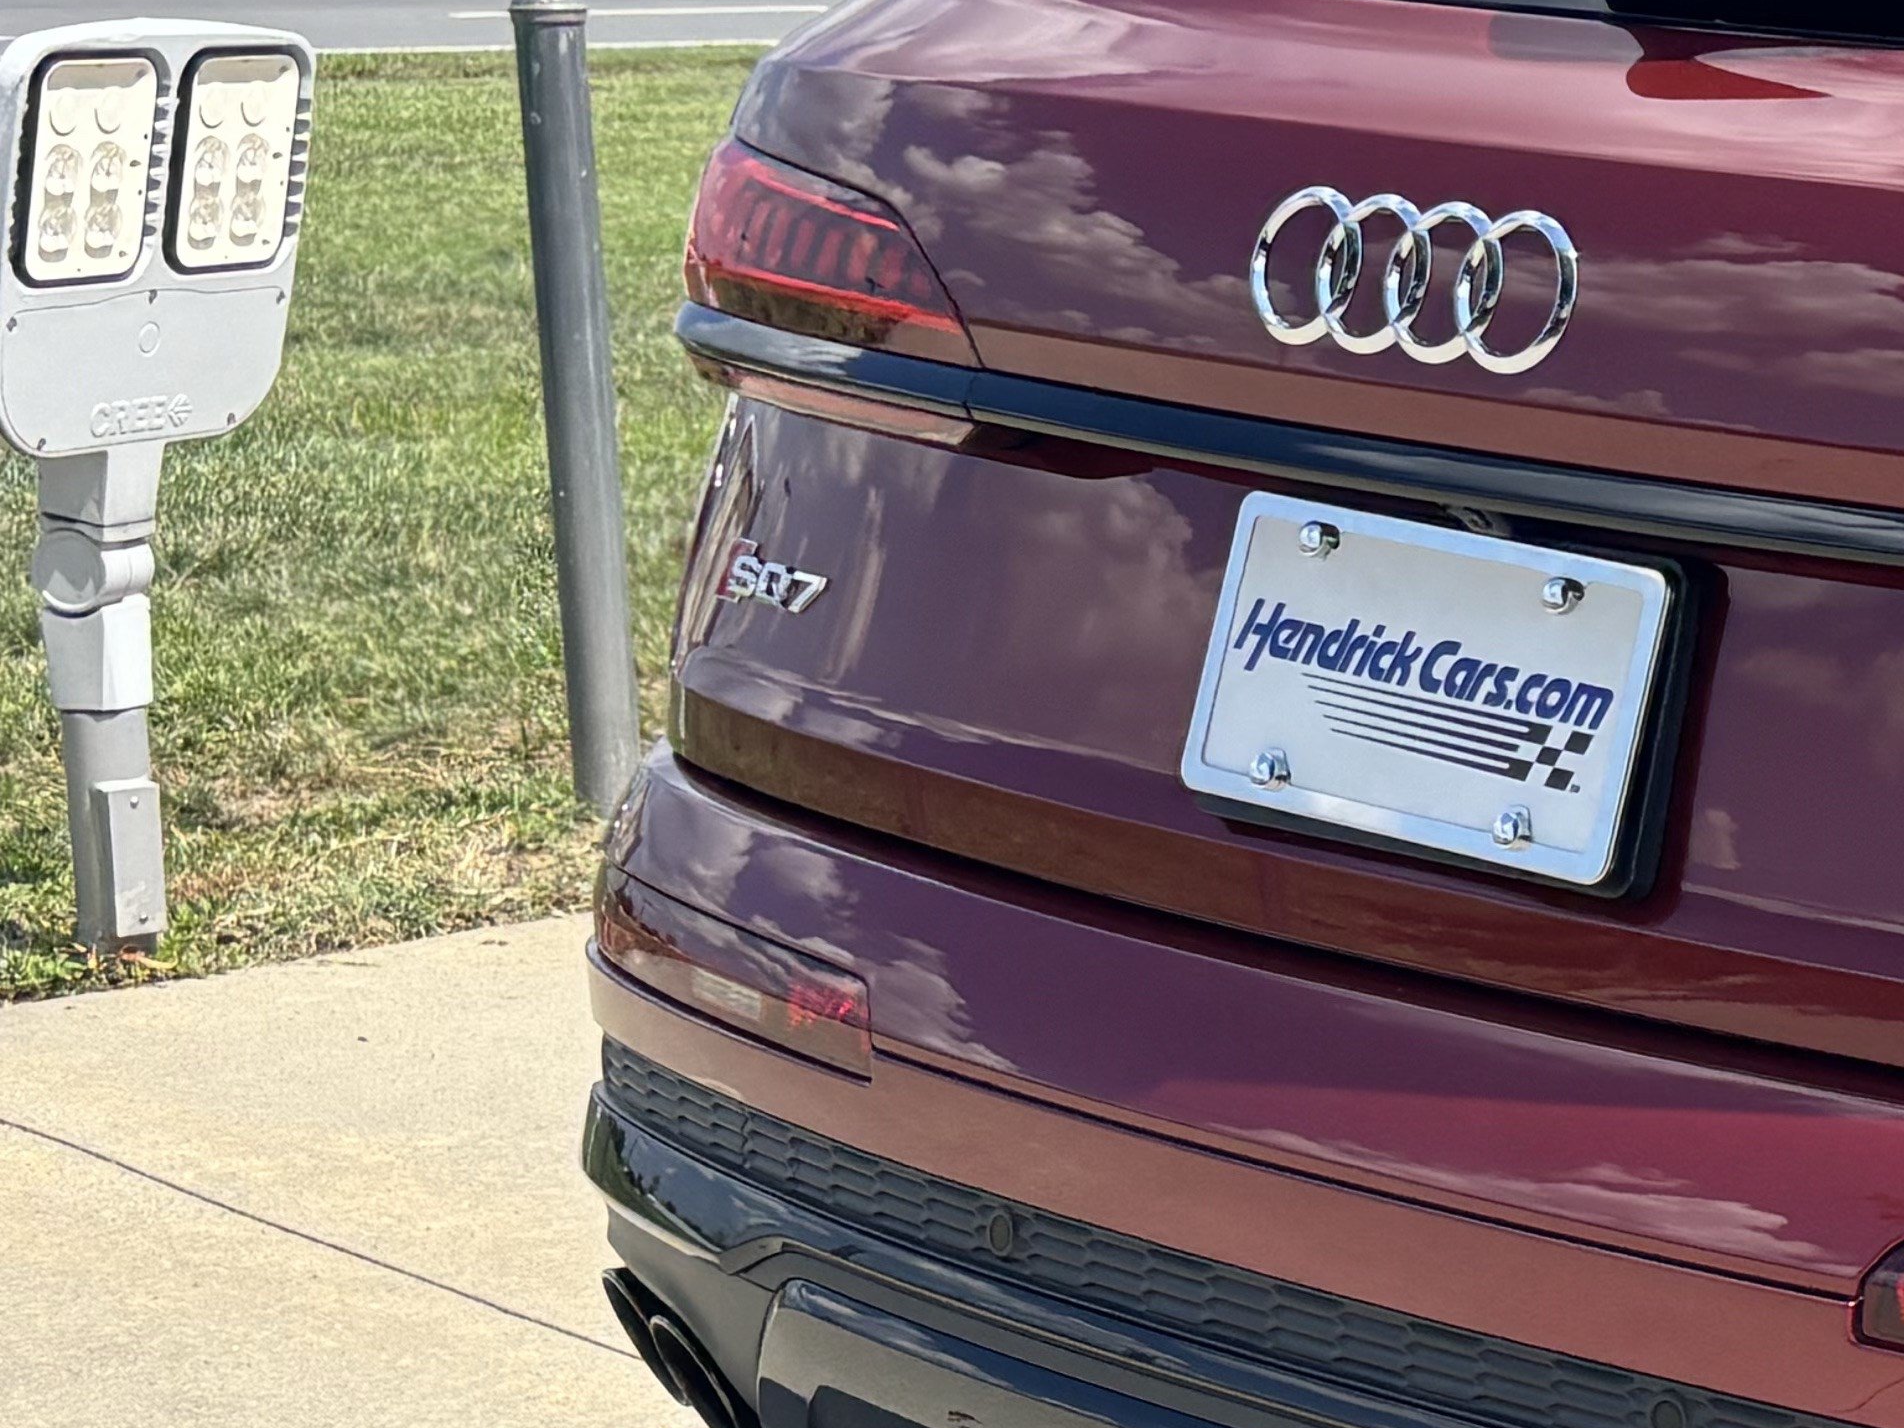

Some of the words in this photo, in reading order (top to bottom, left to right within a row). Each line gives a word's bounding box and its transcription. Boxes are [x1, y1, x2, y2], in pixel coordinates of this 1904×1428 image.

[90, 395, 167, 438] CREE
[726, 555, 828, 613] SQ7
[1233, 597, 1614, 730] HendrickCars.com
